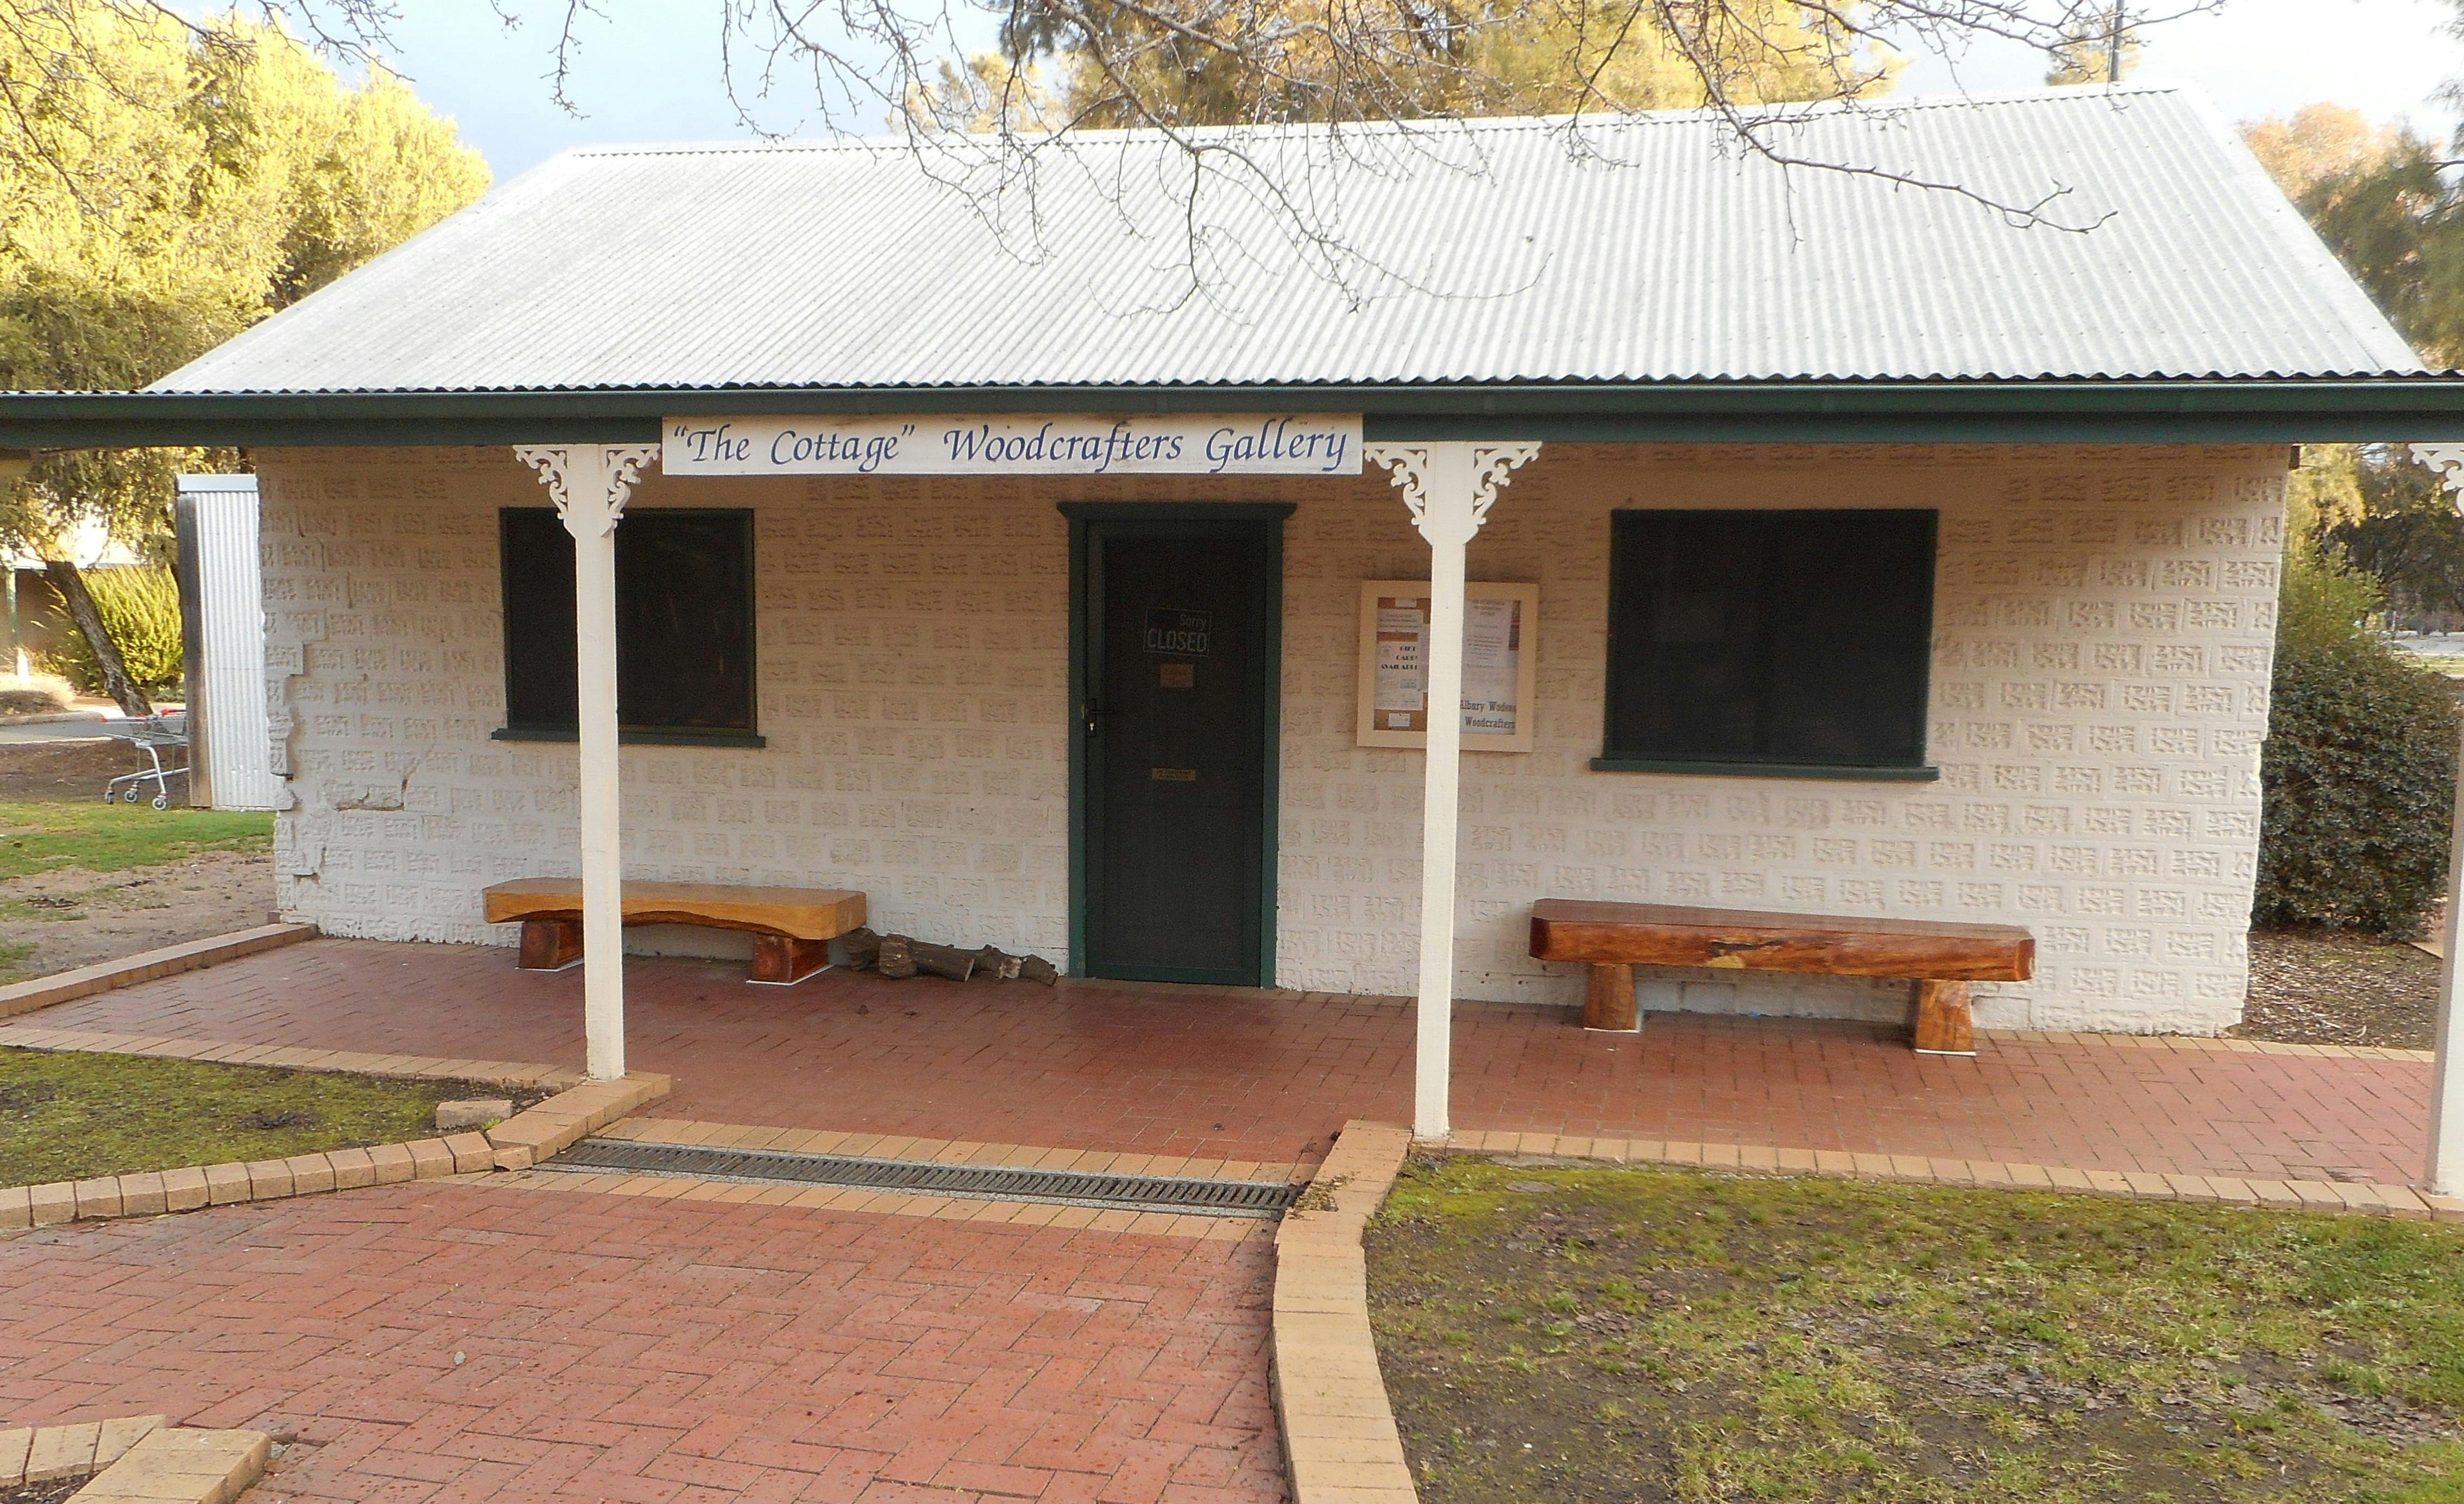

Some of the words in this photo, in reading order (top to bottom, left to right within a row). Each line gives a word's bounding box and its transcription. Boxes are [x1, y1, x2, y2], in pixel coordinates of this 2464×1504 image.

[943, 420, 1184, 473] Woodcrafters
[1206, 417, 1347, 473] Gallery
[1180, 614, 1207, 631] Sorry
[1147, 629, 1207, 652] CLOSED
[1460, 700, 1485, 713] Albury
